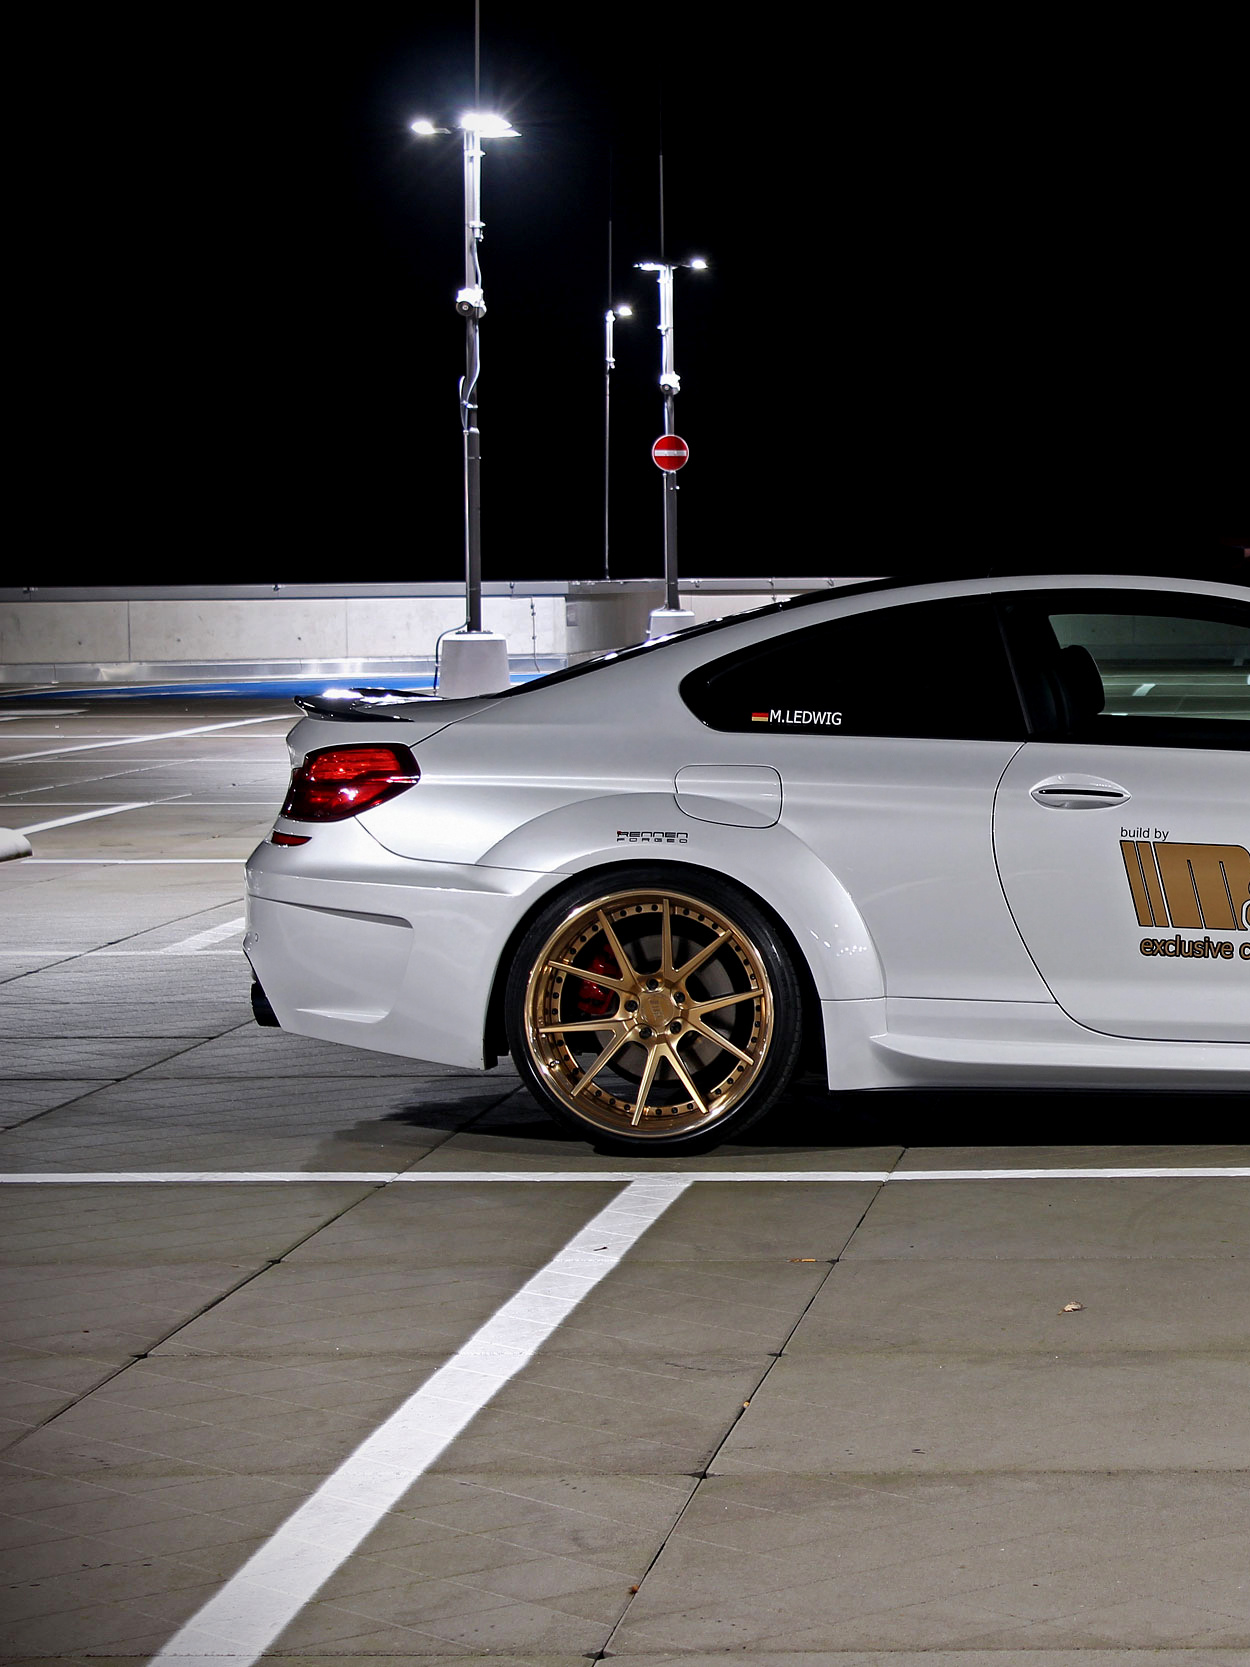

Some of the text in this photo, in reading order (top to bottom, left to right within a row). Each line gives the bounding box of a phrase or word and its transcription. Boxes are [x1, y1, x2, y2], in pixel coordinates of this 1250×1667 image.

[769, 709, 843, 726] M.LEDWIG
[1120, 827, 1170, 841] build by
[1140, 934, 1234, 959] exclusive
